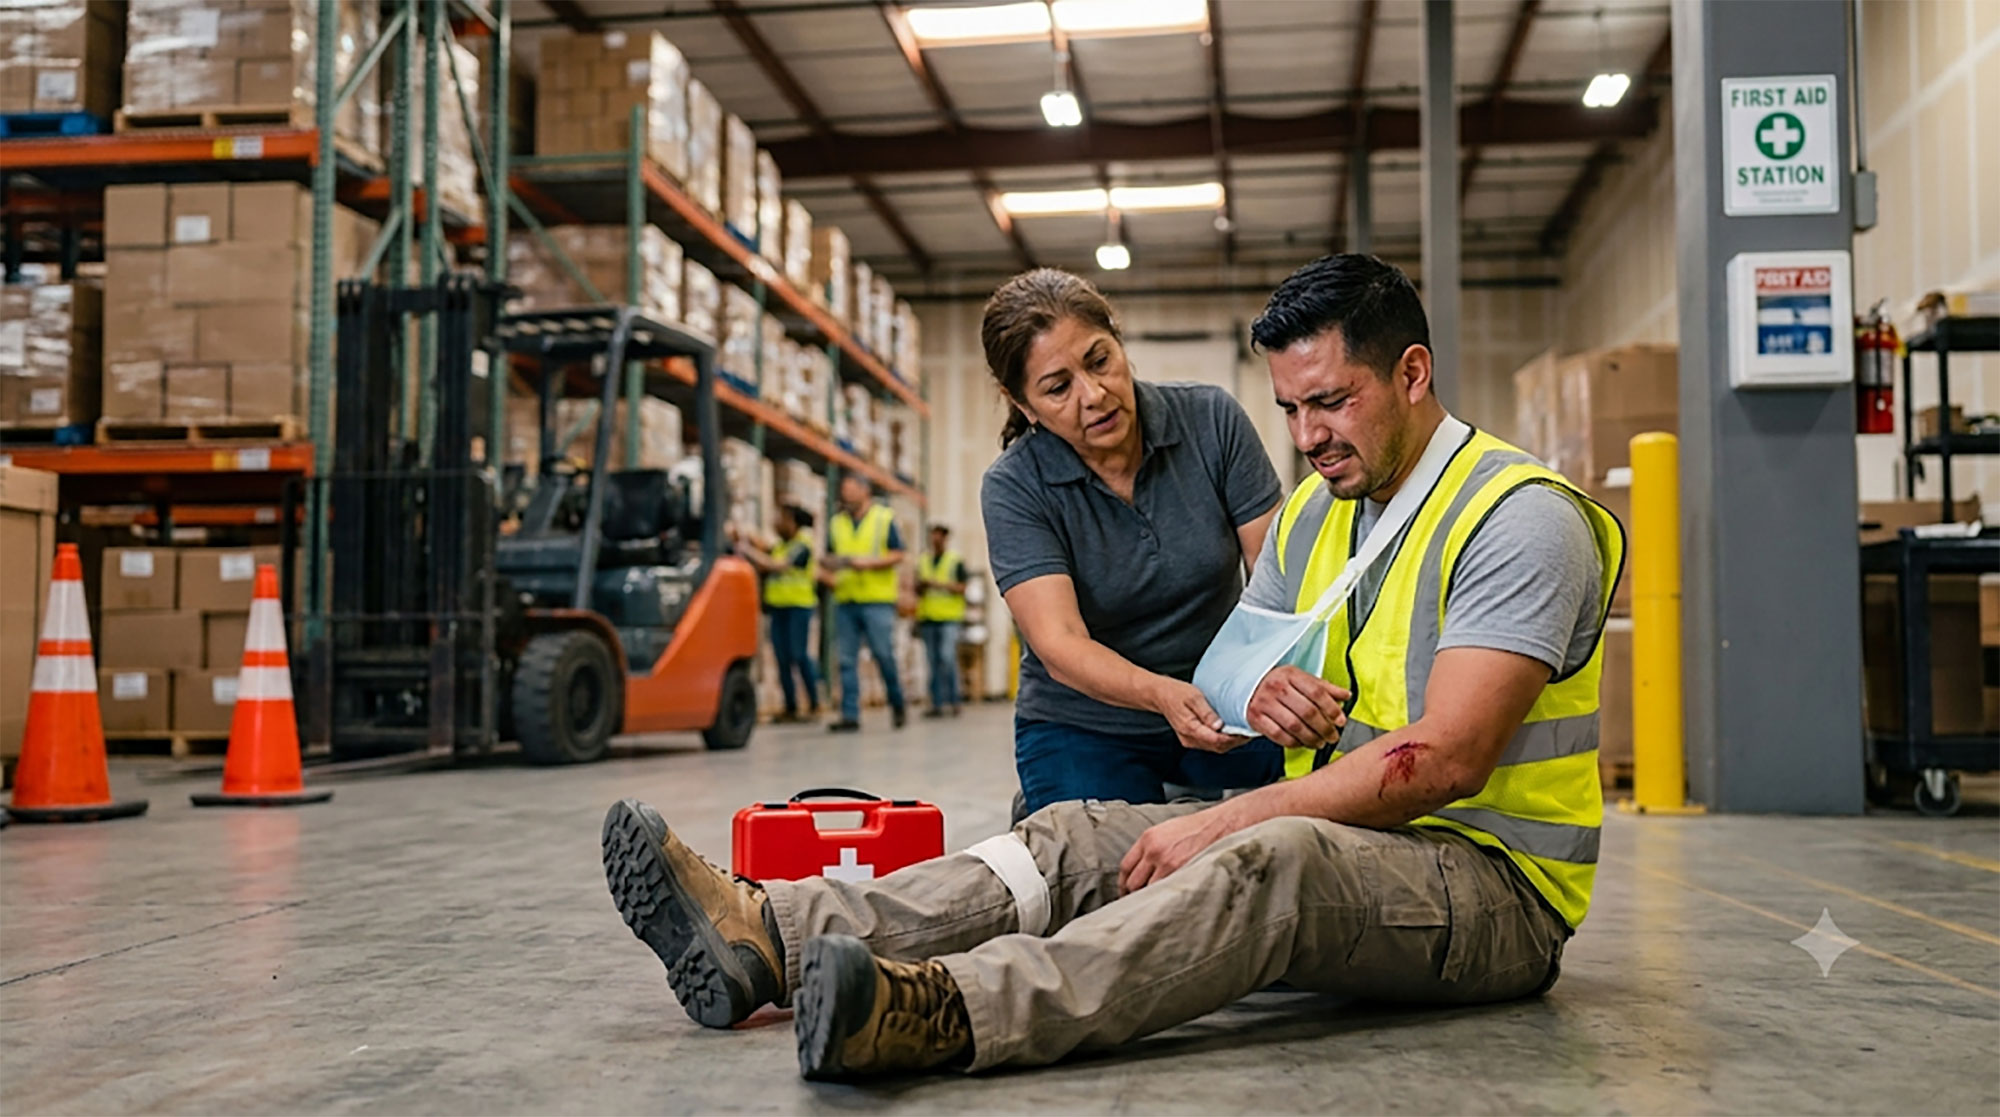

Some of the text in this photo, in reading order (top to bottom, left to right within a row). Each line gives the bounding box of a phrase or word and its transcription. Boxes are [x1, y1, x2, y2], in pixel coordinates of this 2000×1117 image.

[1731, 87, 1827, 107] FIRST AID
[1737, 165, 1824, 186] STATION
